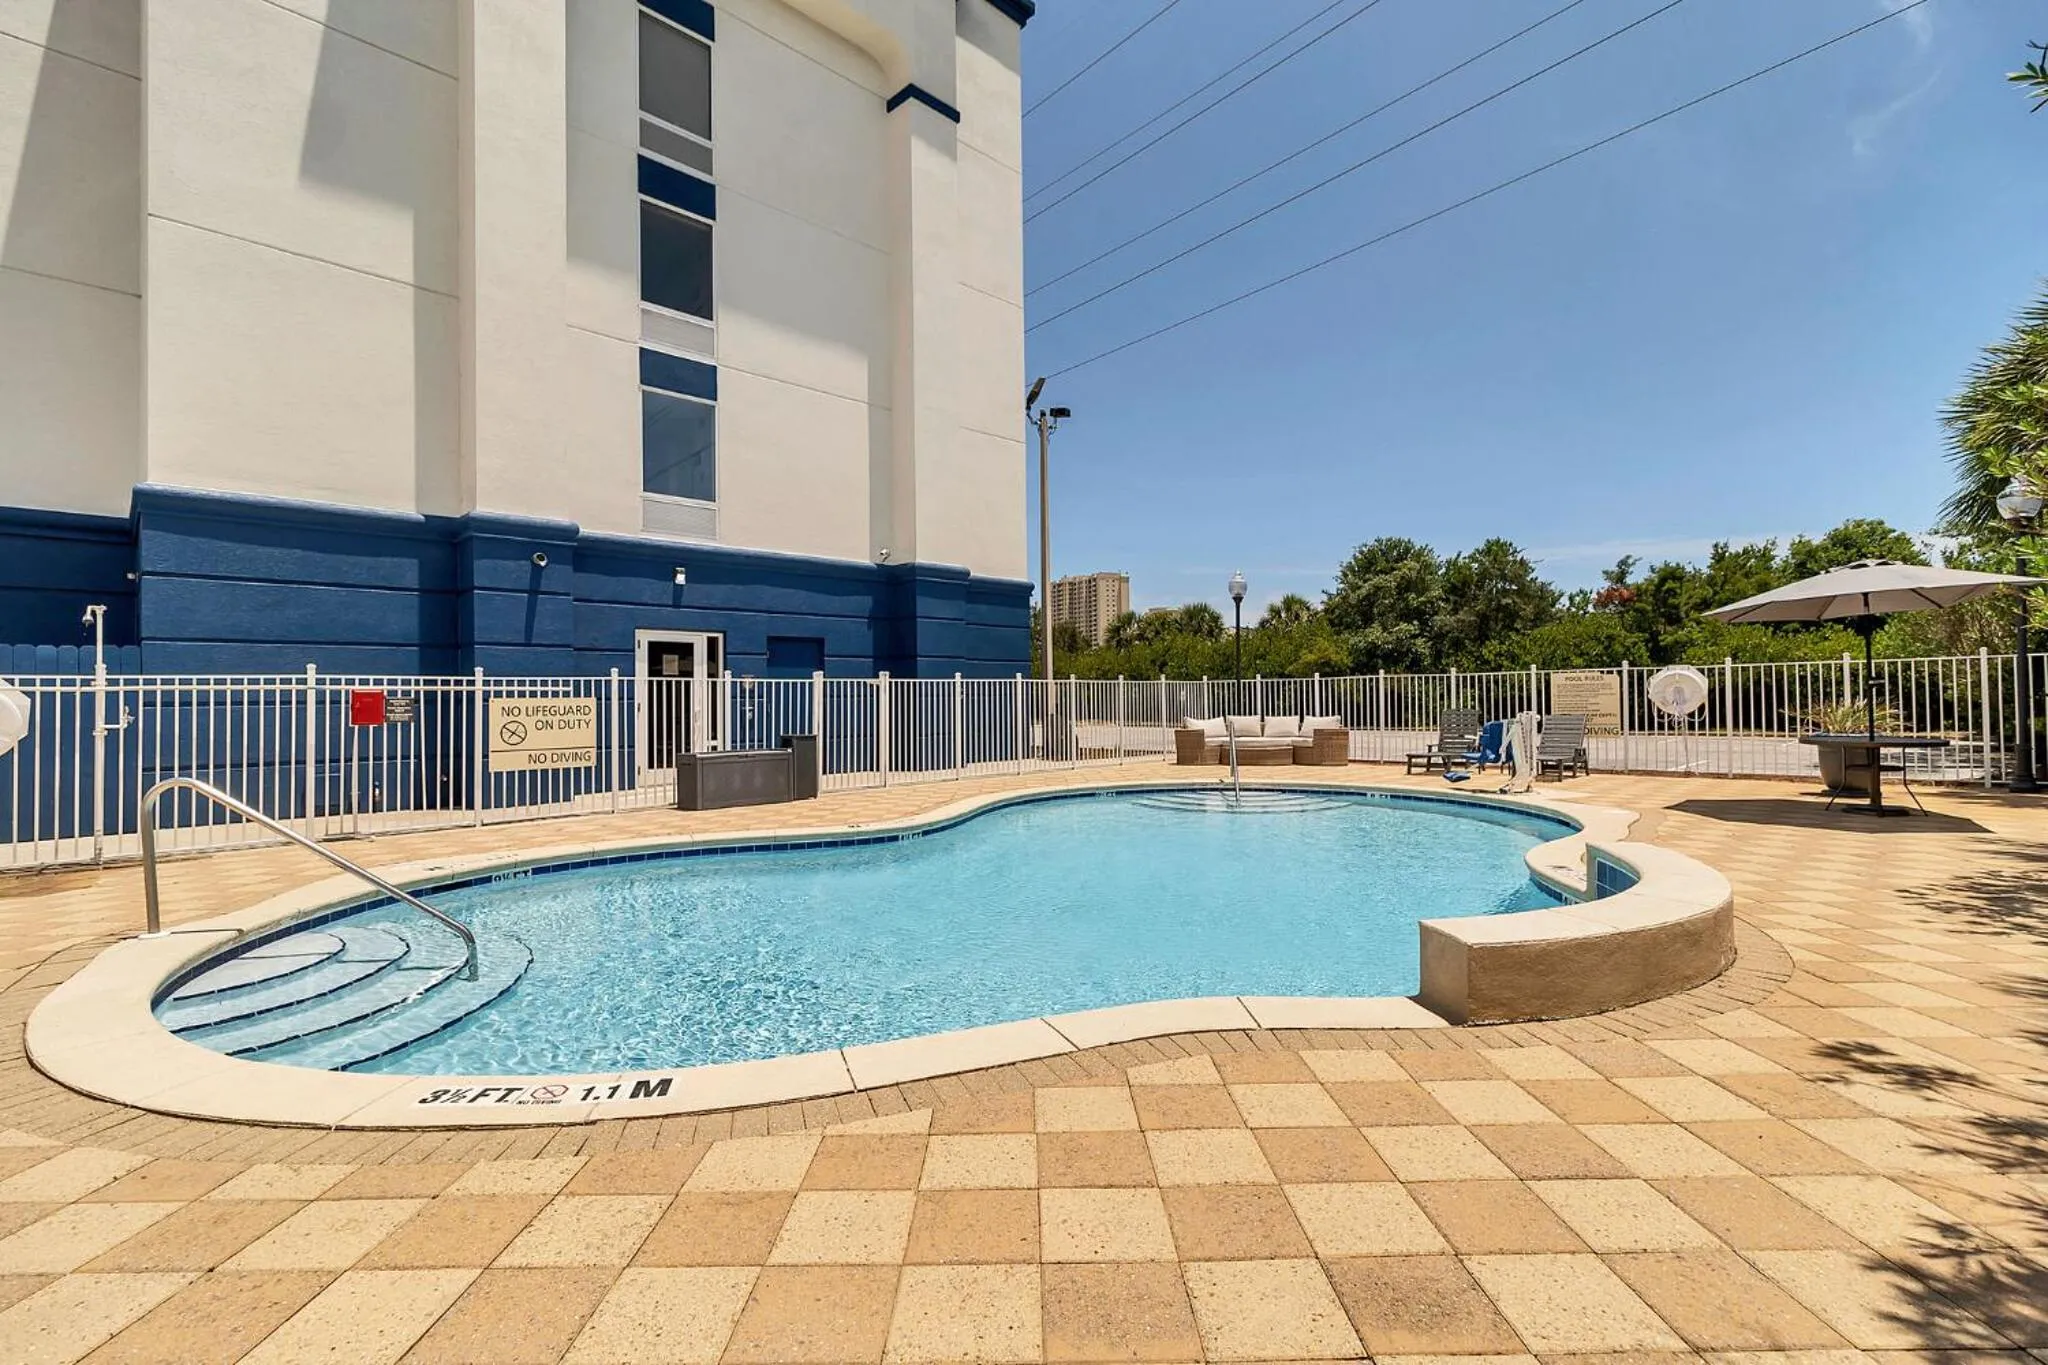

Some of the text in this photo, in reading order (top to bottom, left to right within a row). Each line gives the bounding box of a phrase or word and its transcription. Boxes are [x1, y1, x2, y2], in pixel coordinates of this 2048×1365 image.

[501, 705, 592, 717] NO LIFEGUARD
[534, 719, 592, 731] ON DUTY
[1584, 727, 1620, 736] DIVING
[528, 751, 592, 764] NO DIVING
[580, 1077, 674, 1101] 1.1 M
